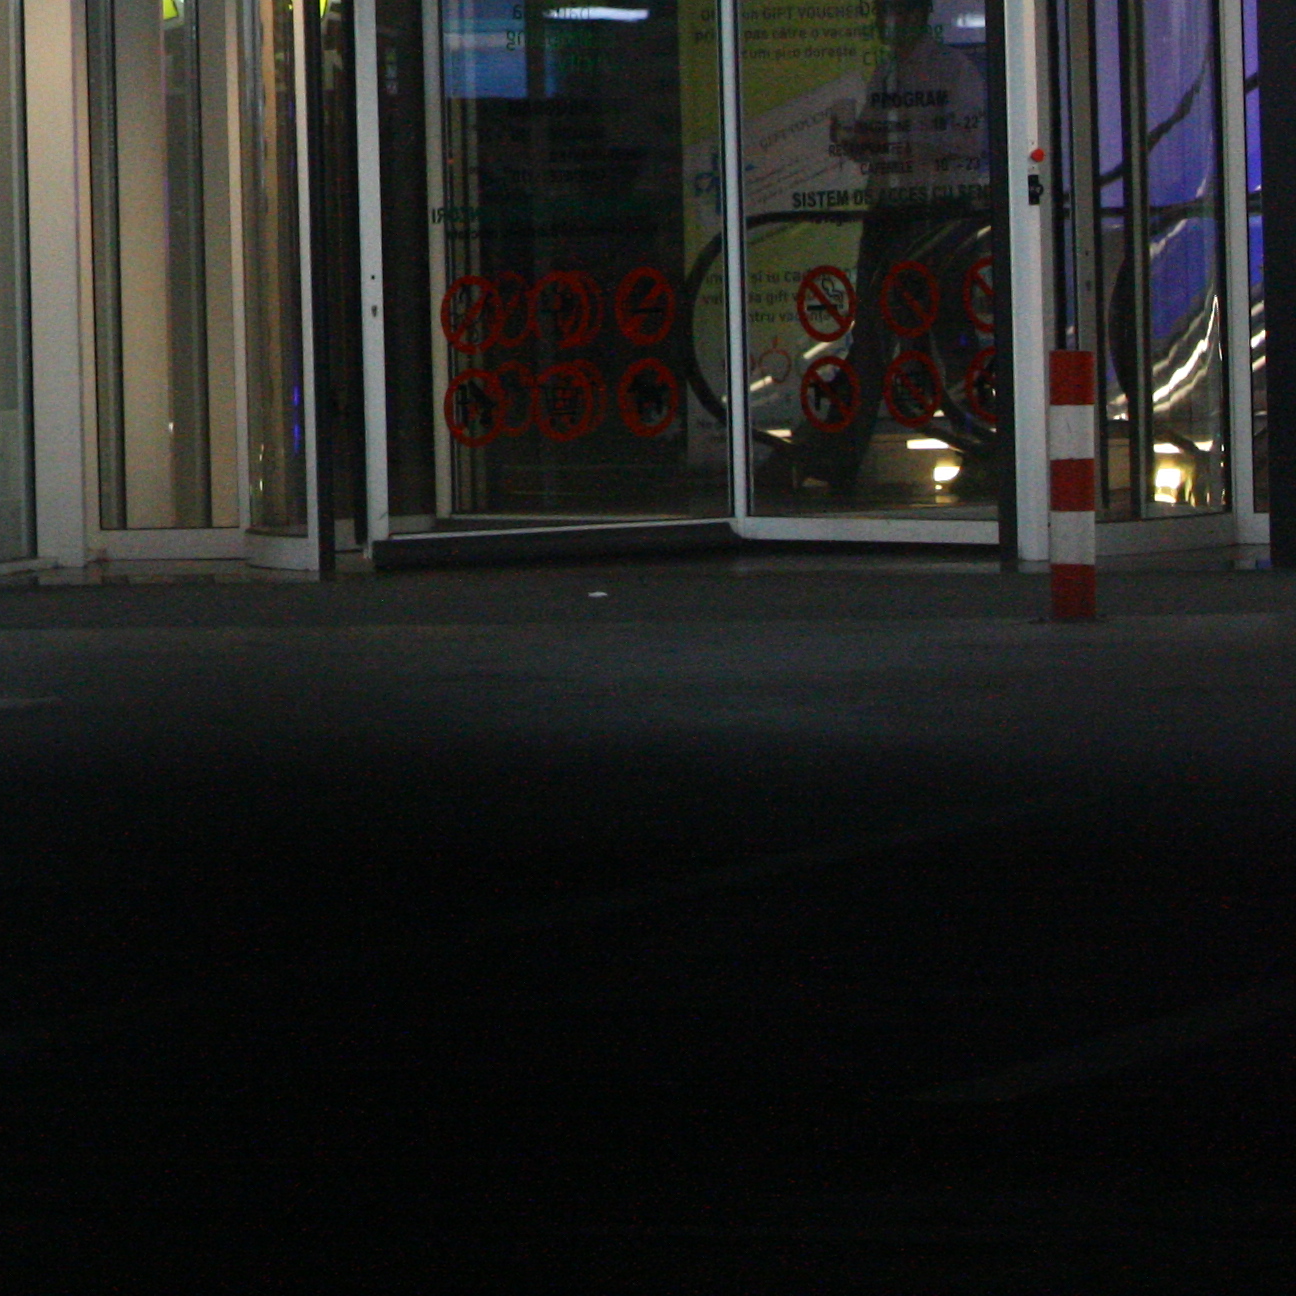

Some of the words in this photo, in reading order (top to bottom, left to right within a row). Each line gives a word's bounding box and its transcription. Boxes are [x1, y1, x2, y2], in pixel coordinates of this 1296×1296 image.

[762, 7, 793, 21] GIFT
[797, 6, 863, 20] VOUCHER
[870, 90, 948, 109] PROGRAM
[792, 190, 849, 208] SISTEM
